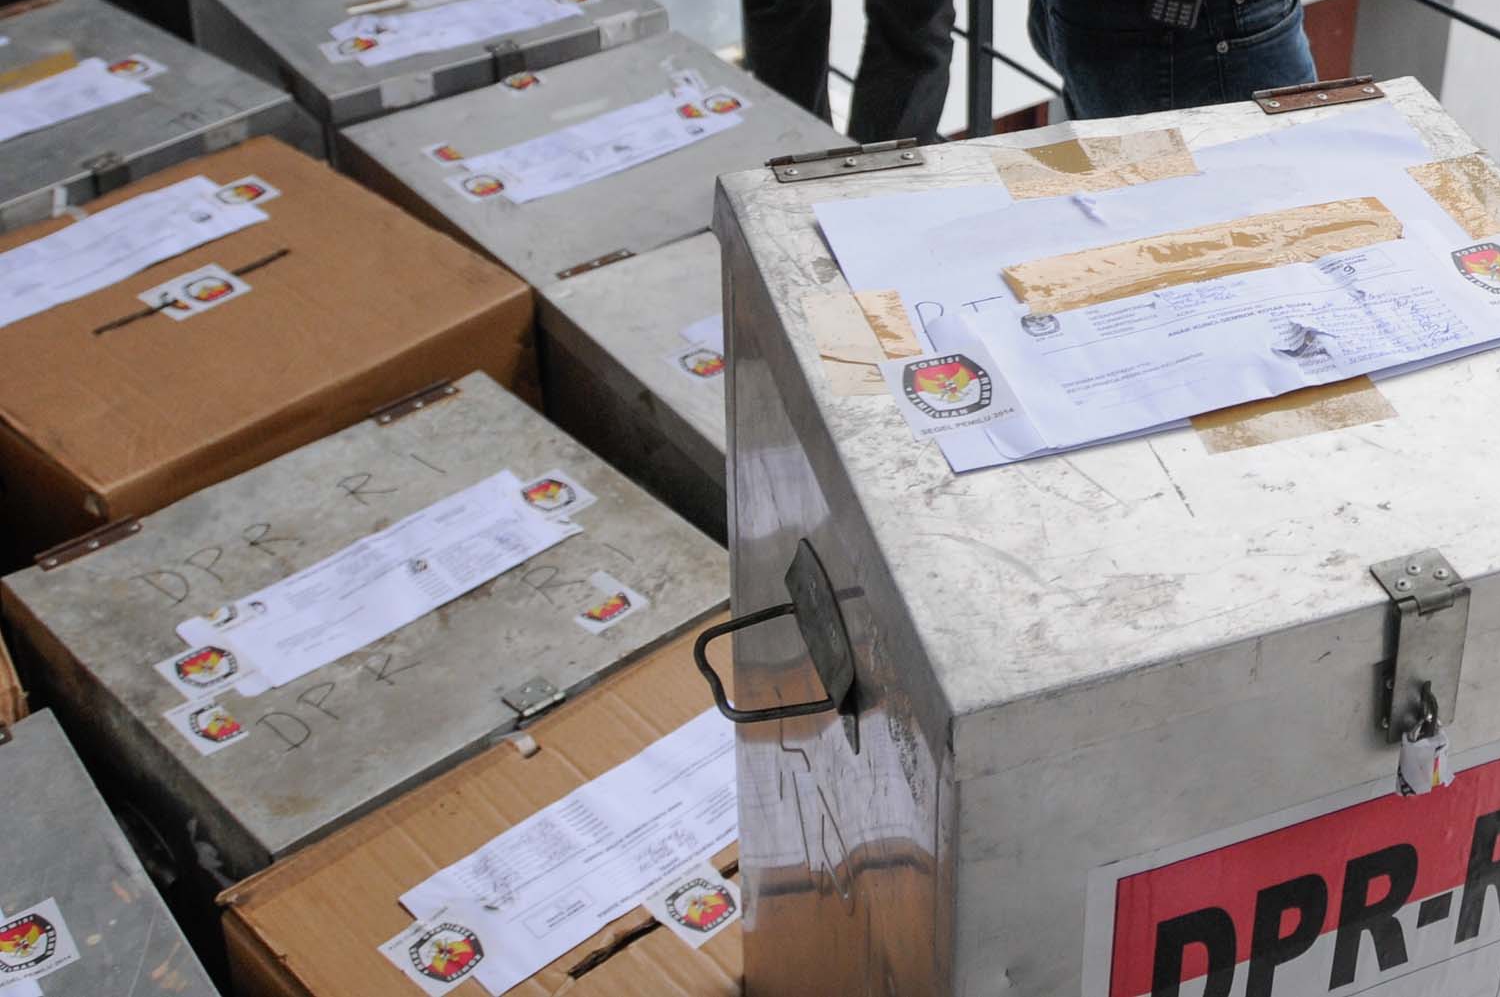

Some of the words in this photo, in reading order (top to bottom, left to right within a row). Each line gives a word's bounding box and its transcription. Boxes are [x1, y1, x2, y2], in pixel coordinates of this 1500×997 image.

[910, 356, 960, 372] KOMISI
[920, 423, 954, 436] SEGEL
[955, 415, 991, 429] PEMILU
